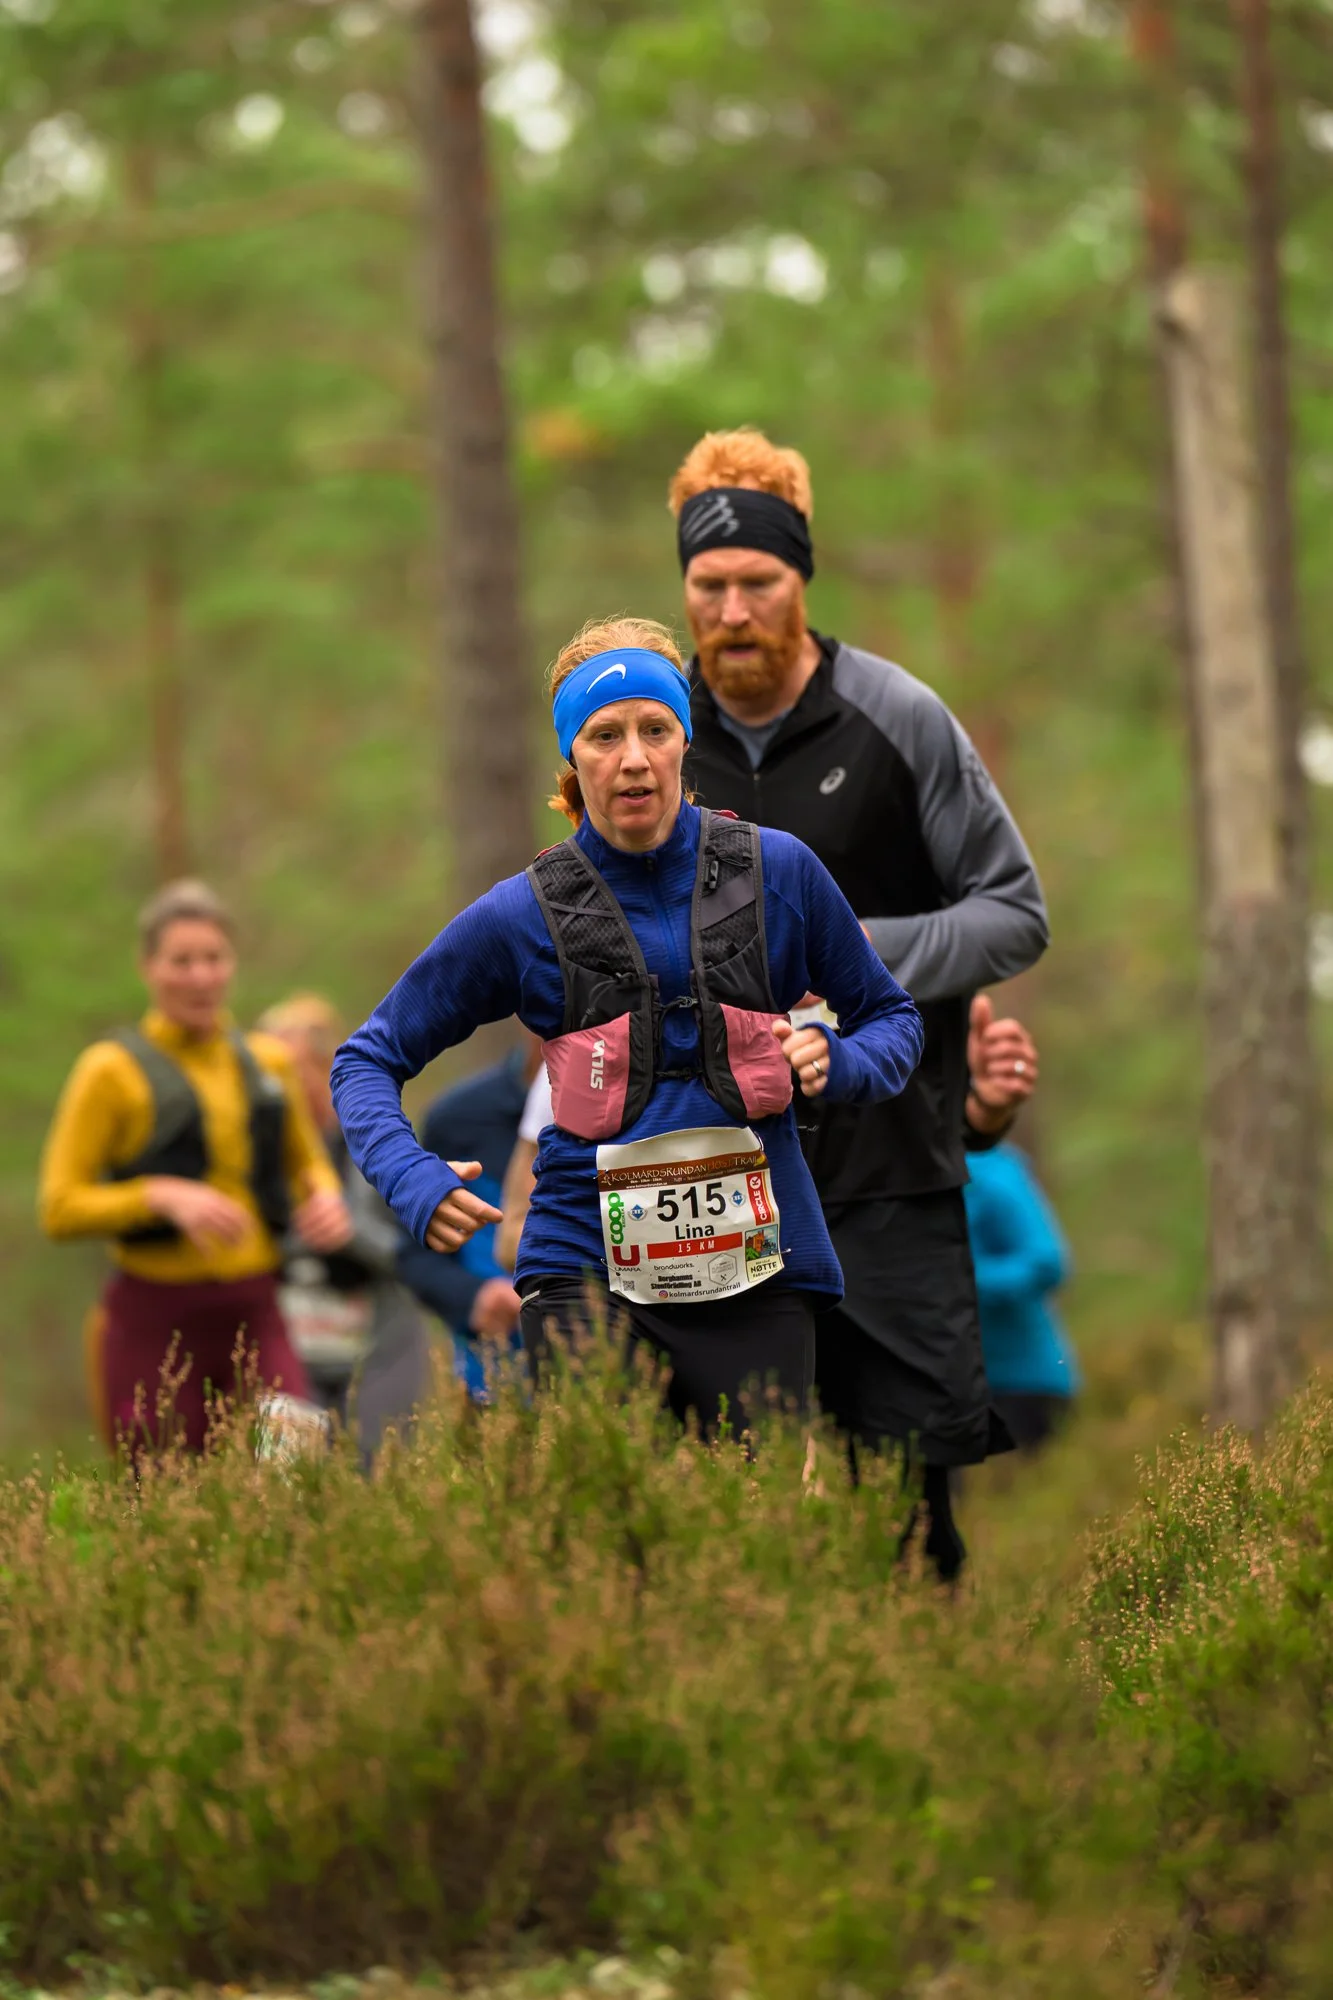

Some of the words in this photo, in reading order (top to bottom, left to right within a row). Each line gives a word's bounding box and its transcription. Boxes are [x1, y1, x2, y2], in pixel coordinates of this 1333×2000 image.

[591, 1039, 605, 1090] SILVA
[657, 1182, 727, 1222] 515
[754, 1190, 768, 1220] CIRCLE
[607, 1192, 625, 1245] coop
[675, 1224, 715, 1240] Lina
[678, 1243, 691, 1253] 15
[700, 1240, 715, 1251] KM
[750, 1261, 777, 1273] NØTTE
[669, 1282, 741, 1297] kolmardsrundantrail
